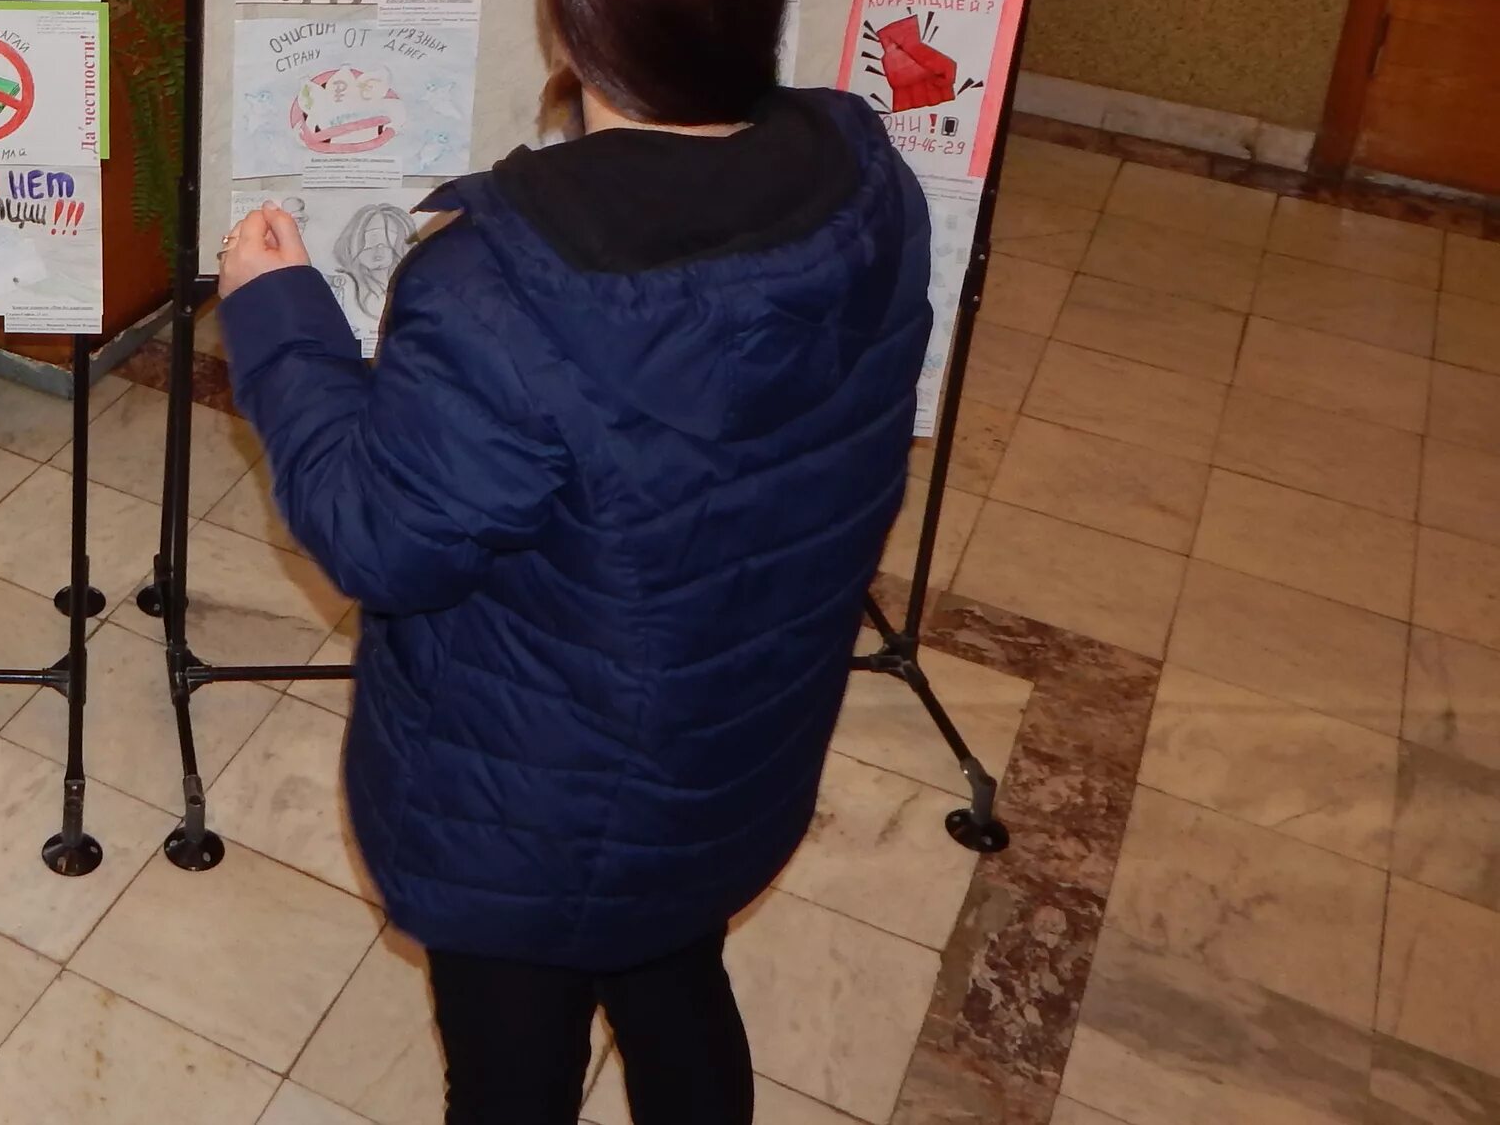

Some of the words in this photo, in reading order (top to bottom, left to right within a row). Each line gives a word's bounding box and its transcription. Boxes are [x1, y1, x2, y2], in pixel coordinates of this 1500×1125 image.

[269, 22, 337, 53] ОЧИСТИМ
[344, 27, 372, 48] ОТ
[275, 48, 322, 73] СТРАНУ
[383, 39, 428, 61] ДЕНЕГ
